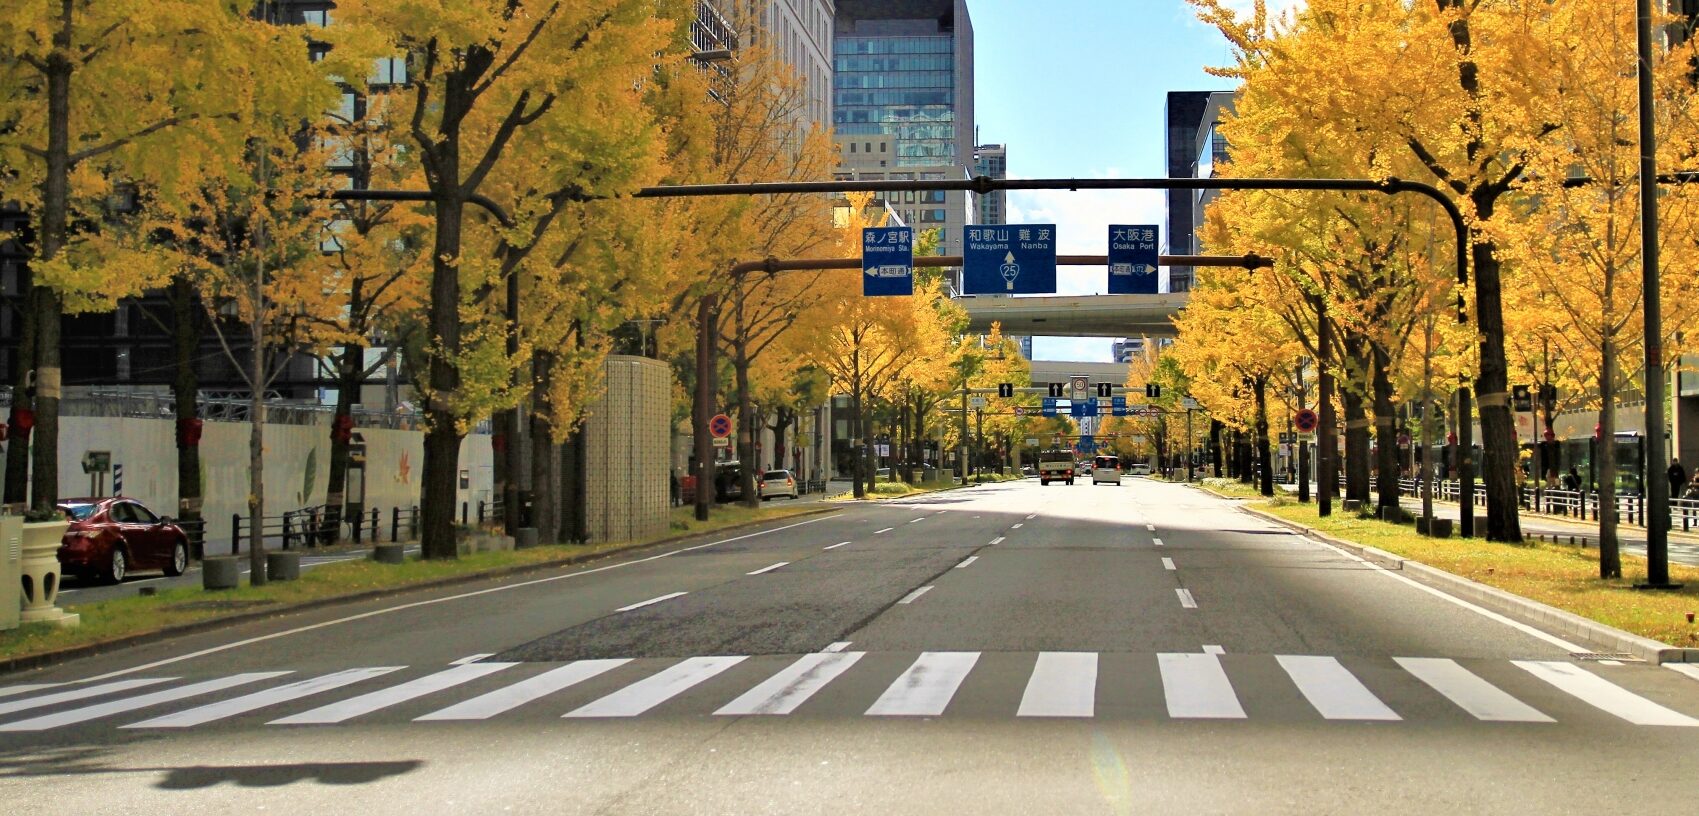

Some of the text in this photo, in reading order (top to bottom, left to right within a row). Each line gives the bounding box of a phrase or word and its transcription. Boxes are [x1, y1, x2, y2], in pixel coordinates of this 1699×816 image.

[865, 230, 910, 244] 森ノ宮駅
[968, 228, 1008, 242] 和歌山
[1113, 229, 1154, 241] 大阪港
[880, 267, 904, 275] 本町通
[1003, 265, 1016, 276] 25
